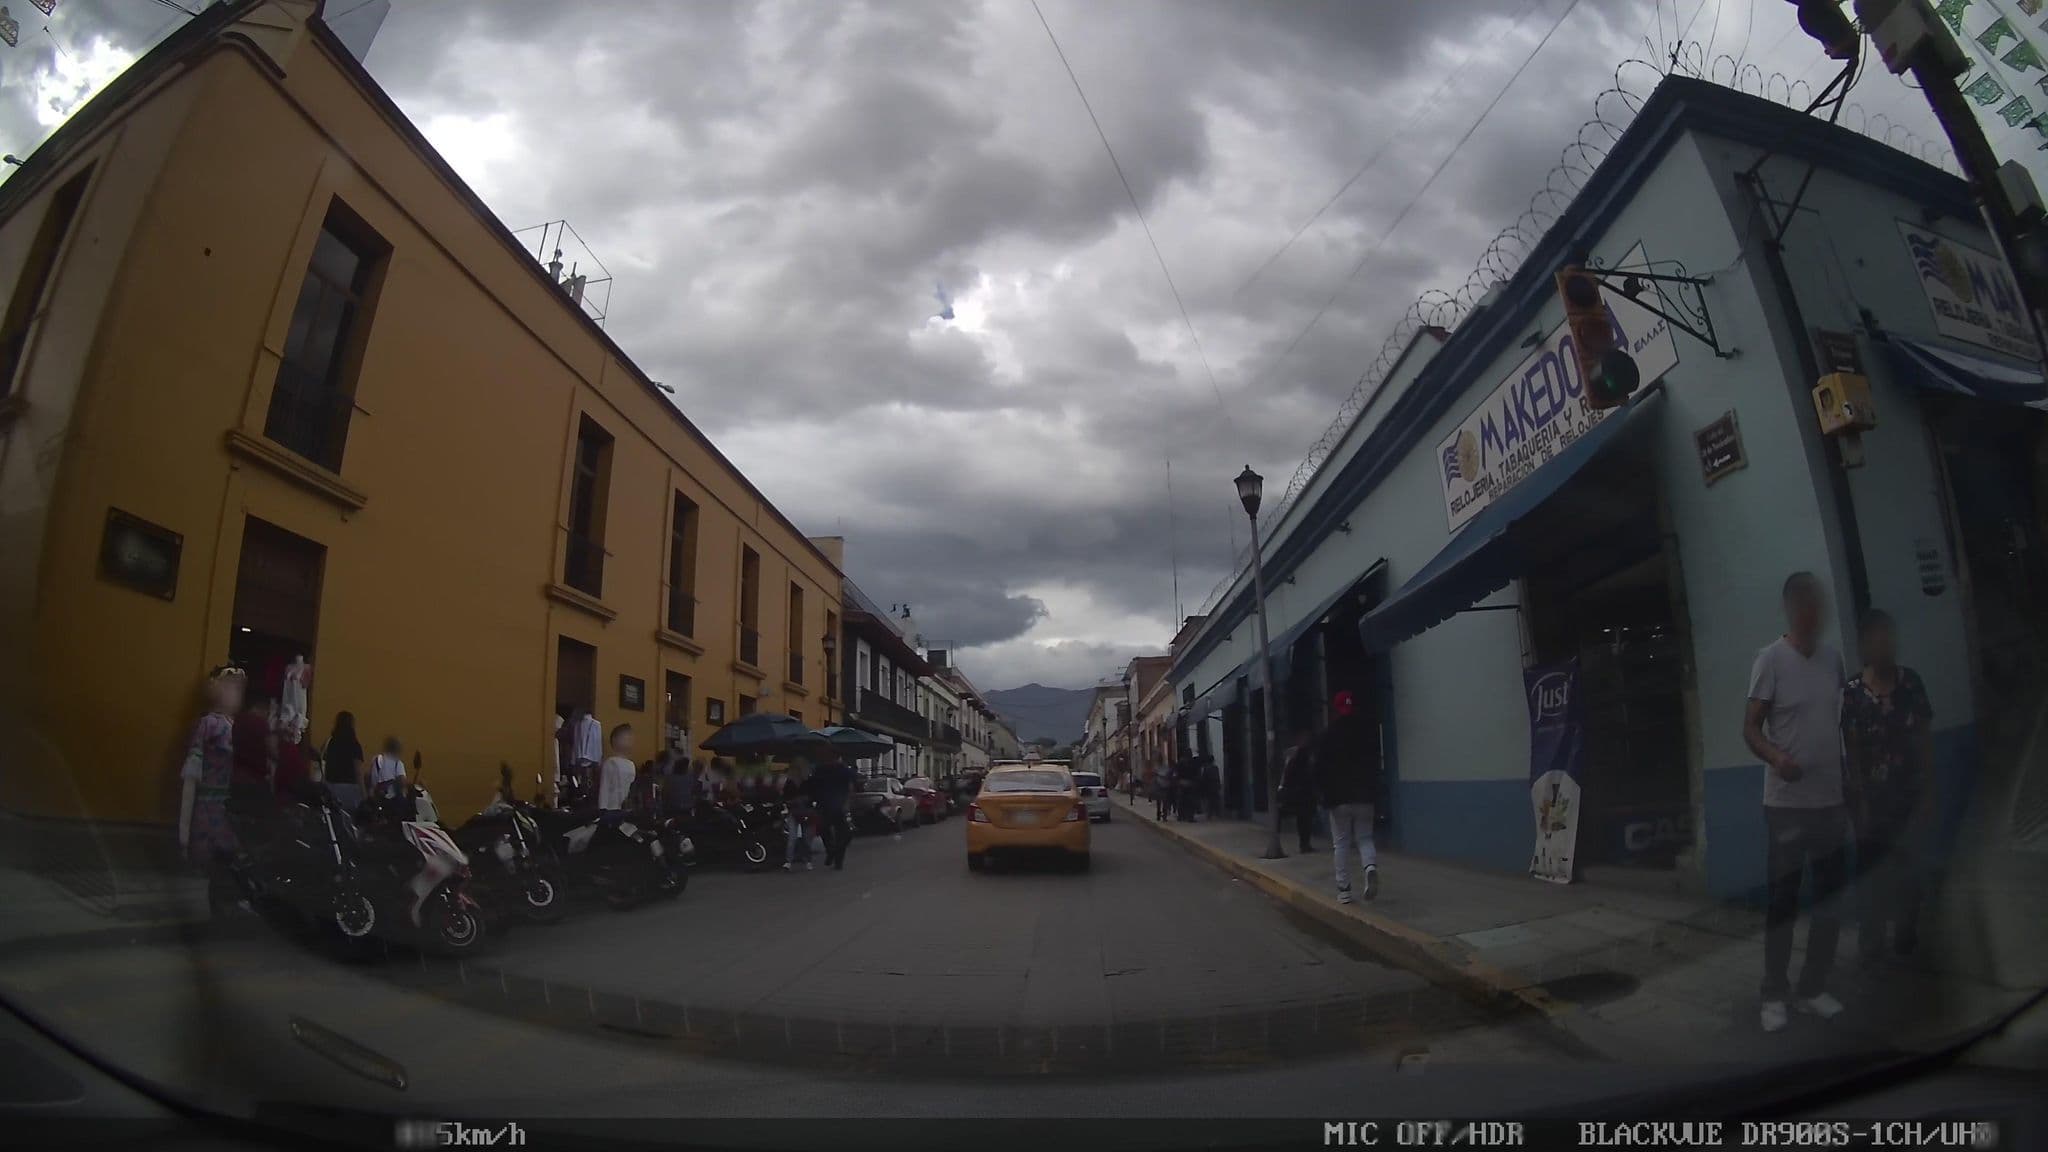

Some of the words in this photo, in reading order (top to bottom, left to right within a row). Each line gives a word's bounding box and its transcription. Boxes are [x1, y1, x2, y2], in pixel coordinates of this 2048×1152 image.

[1488, 458, 1536, 501] REPARACION
[1540, 444, 1554, 464] DE
[1560, 409, 1605, 449] RELOJES
[1498, 420, 1561, 480] TABAQUERIA
[1563, 406, 1573, 428] Y
[1536, 681, 1569, 721] Just
